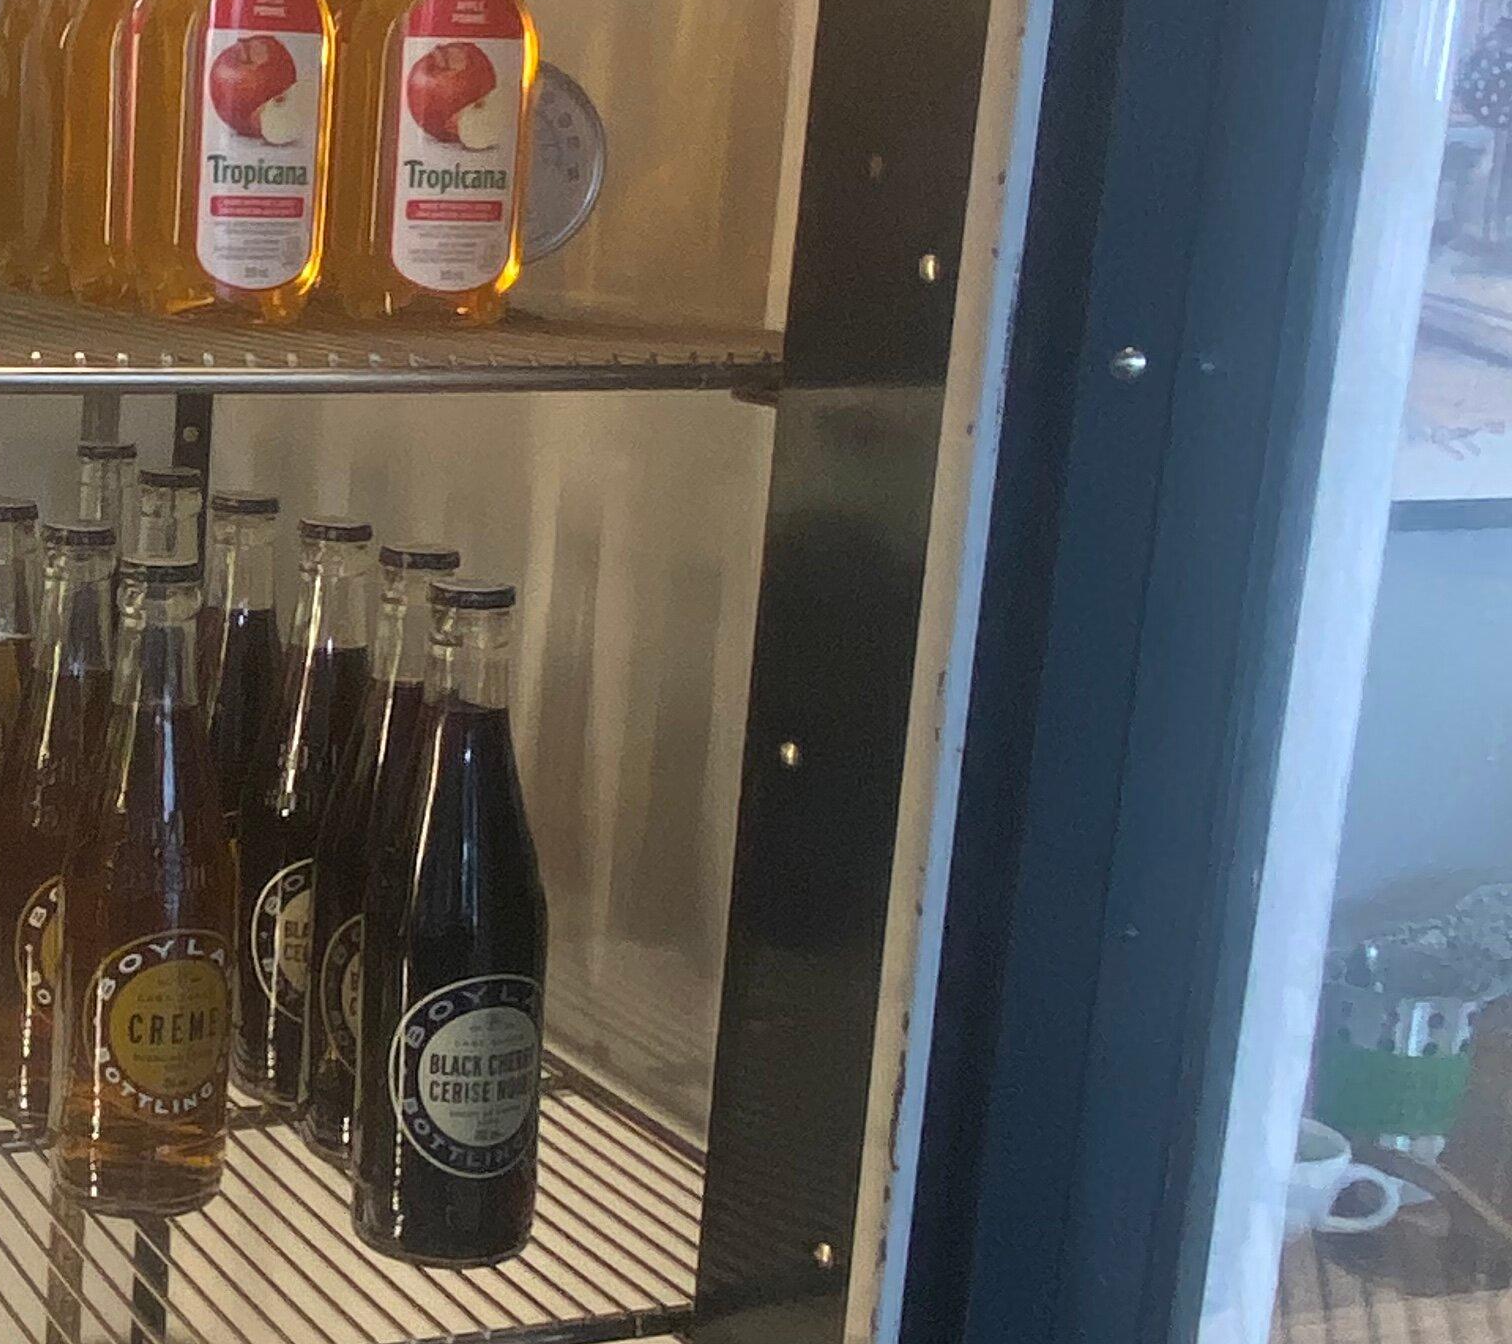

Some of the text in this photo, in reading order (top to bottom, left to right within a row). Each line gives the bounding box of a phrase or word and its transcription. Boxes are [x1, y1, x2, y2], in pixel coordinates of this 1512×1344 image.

[207, 154, 308, 190] Tropicana
[404, 159, 508, 195] Tropicana
[430, 1052, 482, 1077] BLACK
[429, 1081, 492, 1104] CERISE
